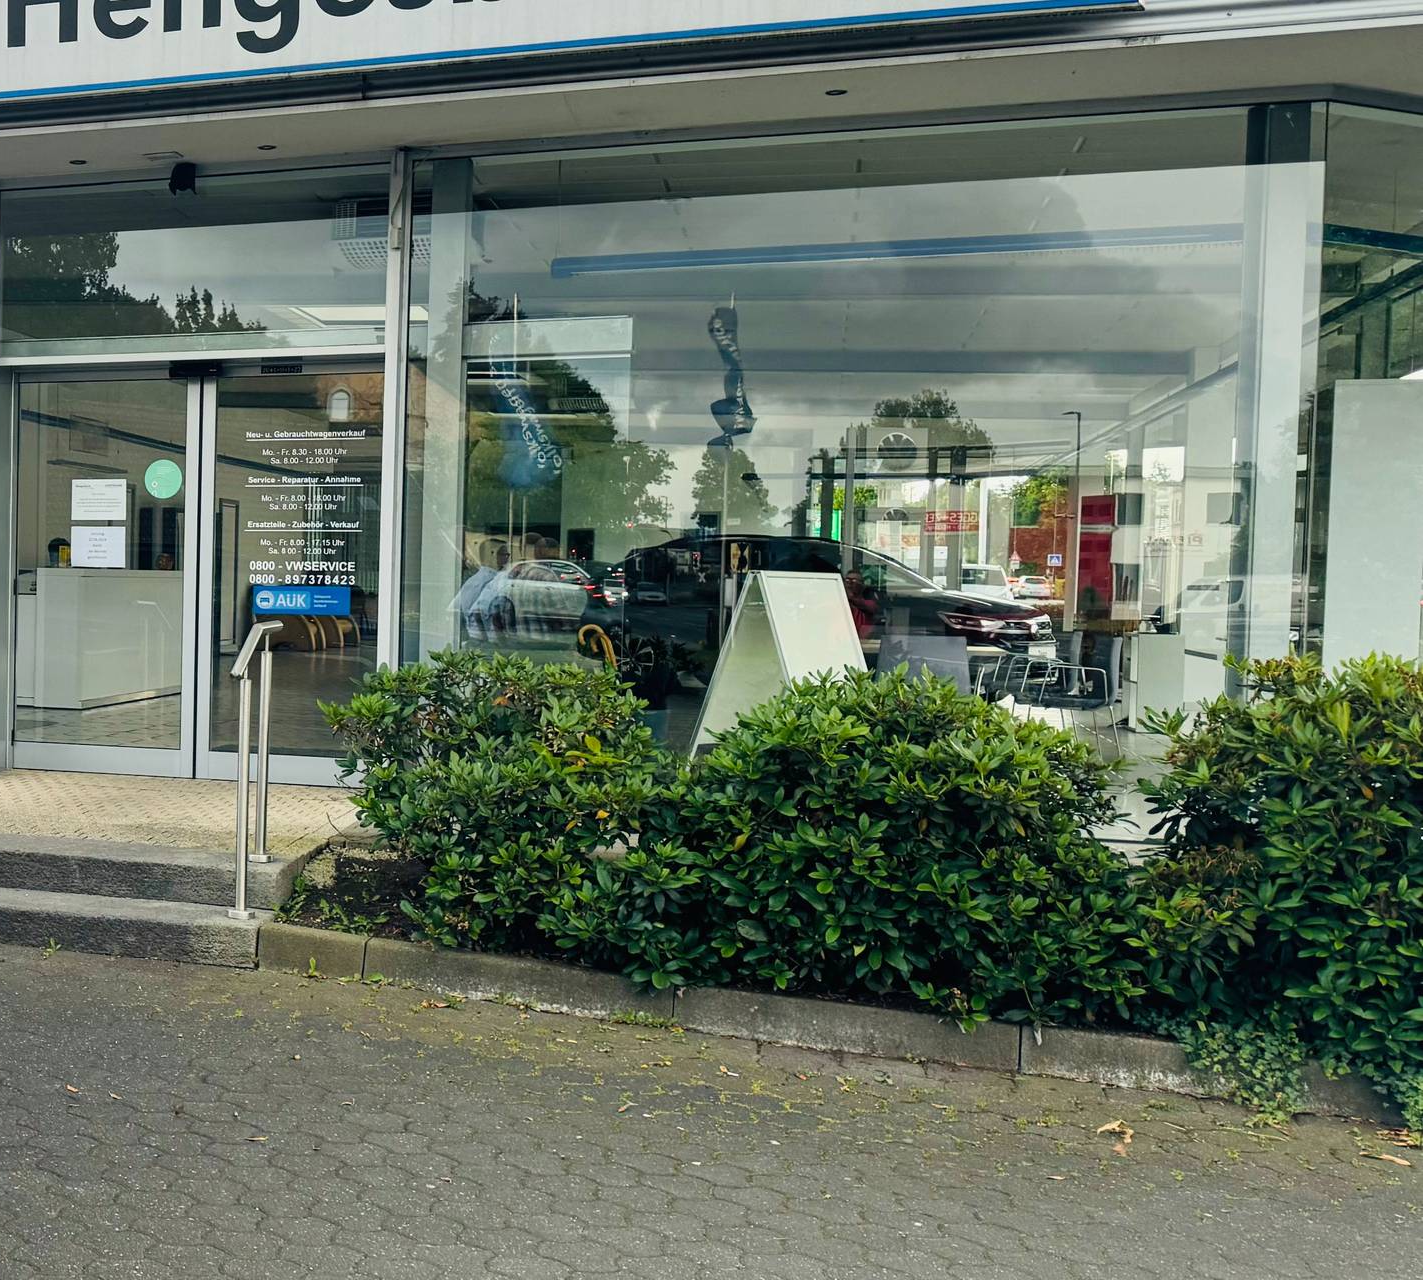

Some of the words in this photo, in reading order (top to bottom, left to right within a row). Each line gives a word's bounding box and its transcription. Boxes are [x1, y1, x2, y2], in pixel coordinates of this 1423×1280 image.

[274, 430, 366, 439] Gebrauchtwagenverkauf
[262, 448, 275, 456] Mo.
[305, 456, 324, 464] 12.00
[248, 476, 275, 484] Service
[282, 476, 319, 485] Reparatur
[249, 561, 275, 571] 0800
[285, 561, 356, 572] VWSERVICE
[249, 574, 275, 584] 0800
[284, 574, 356, 585] 897378423
